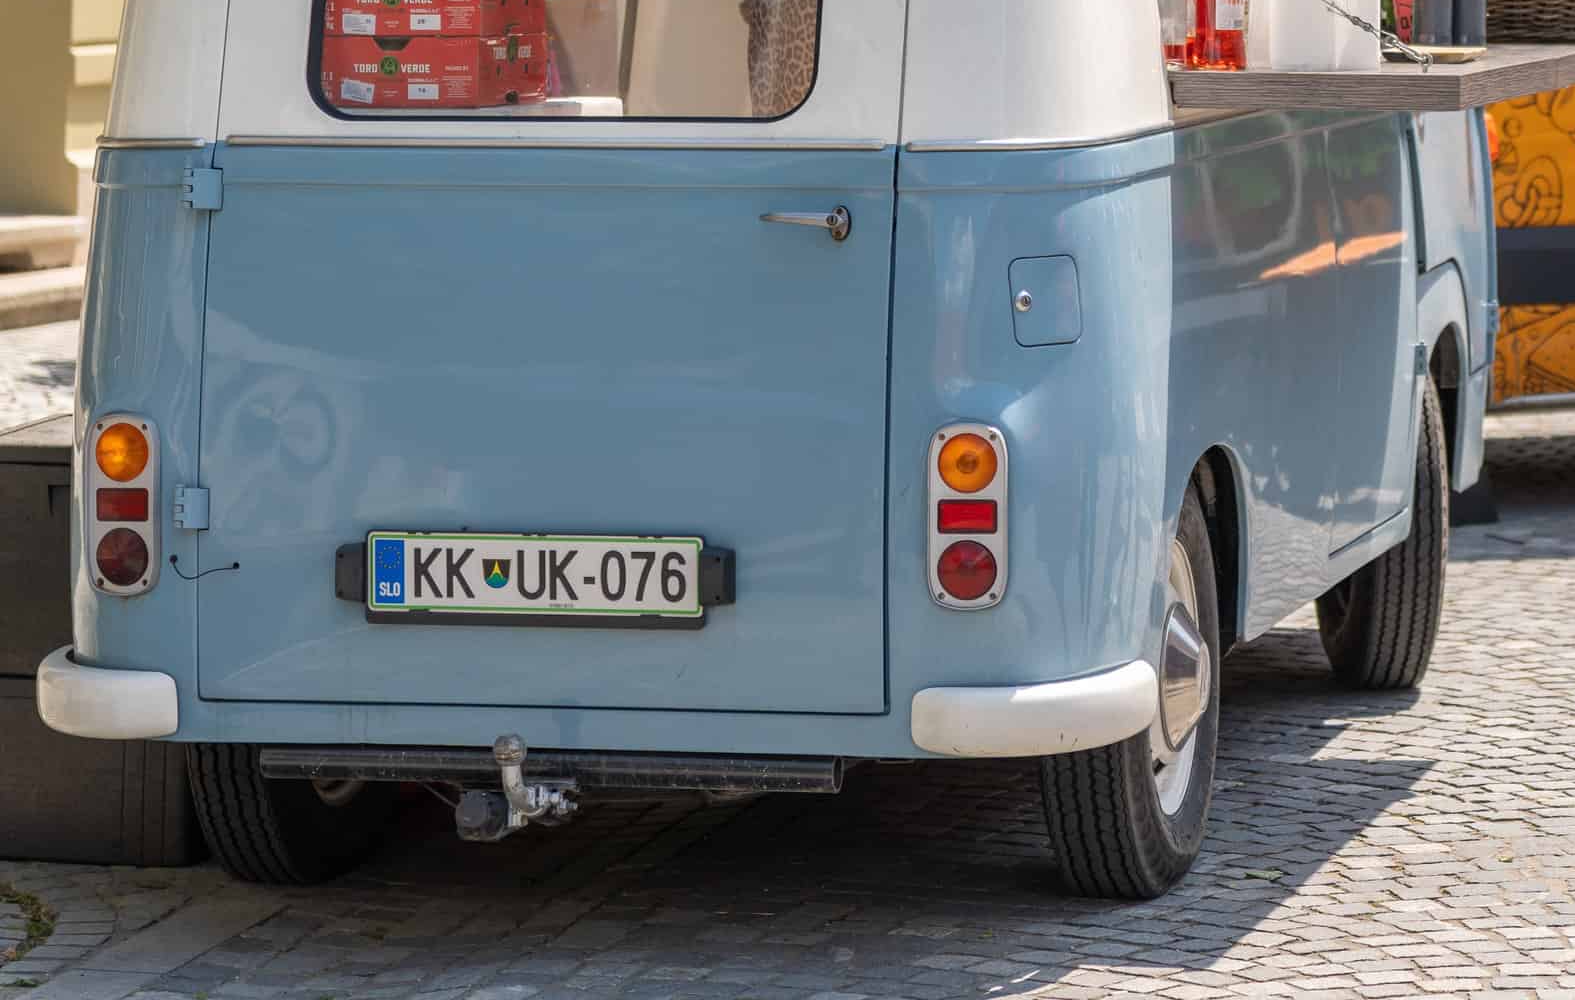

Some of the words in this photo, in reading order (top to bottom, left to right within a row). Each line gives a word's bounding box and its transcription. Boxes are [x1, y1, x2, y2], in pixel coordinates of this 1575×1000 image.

[353, 63, 378, 73] TORO
[400, 63, 431, 73] VERDE
[412, 547, 475, 599] KK
[516, 549, 688, 603] UK-076
[378, 580, 402, 598] SLO
